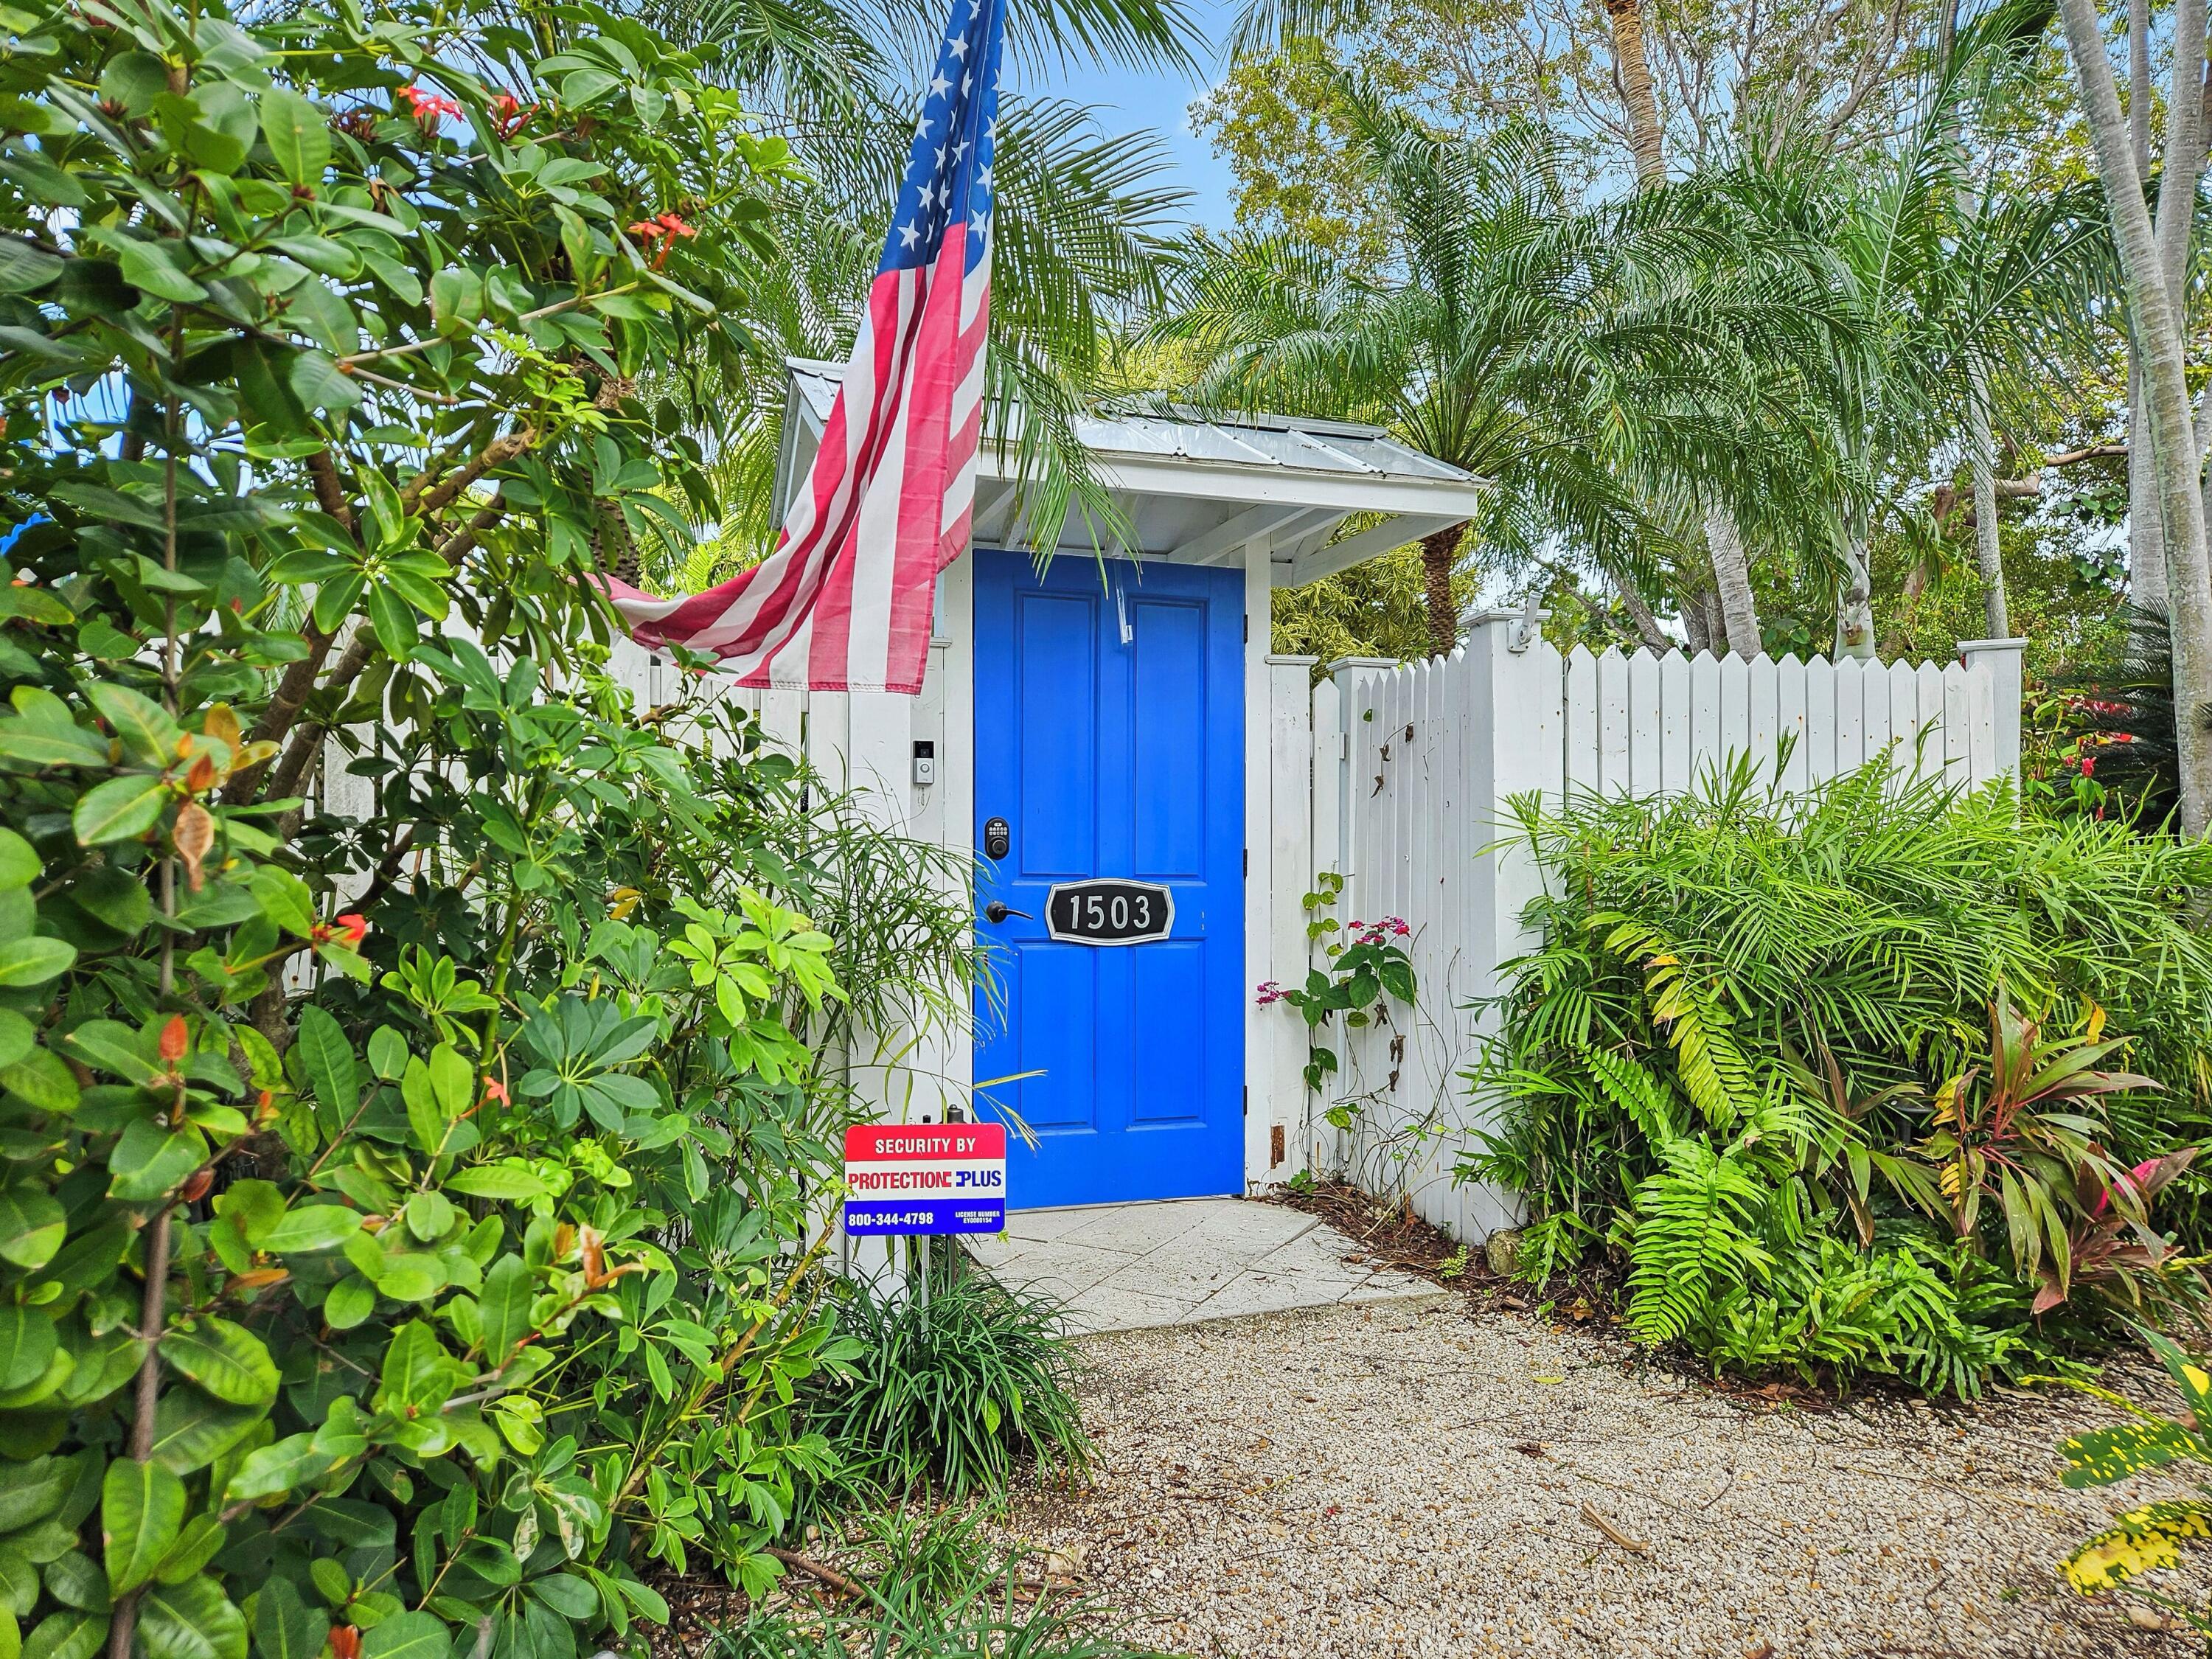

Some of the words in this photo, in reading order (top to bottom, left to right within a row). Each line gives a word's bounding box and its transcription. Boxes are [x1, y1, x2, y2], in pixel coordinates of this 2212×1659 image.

[1071, 895, 1150, 930] 1503
[875, 1138, 950, 1154] SECURITY
[956, 1138, 976, 1152] BY
[956, 1170, 1001, 1188] PLUS
[849, 1212, 933, 1227] 800-344-4798
